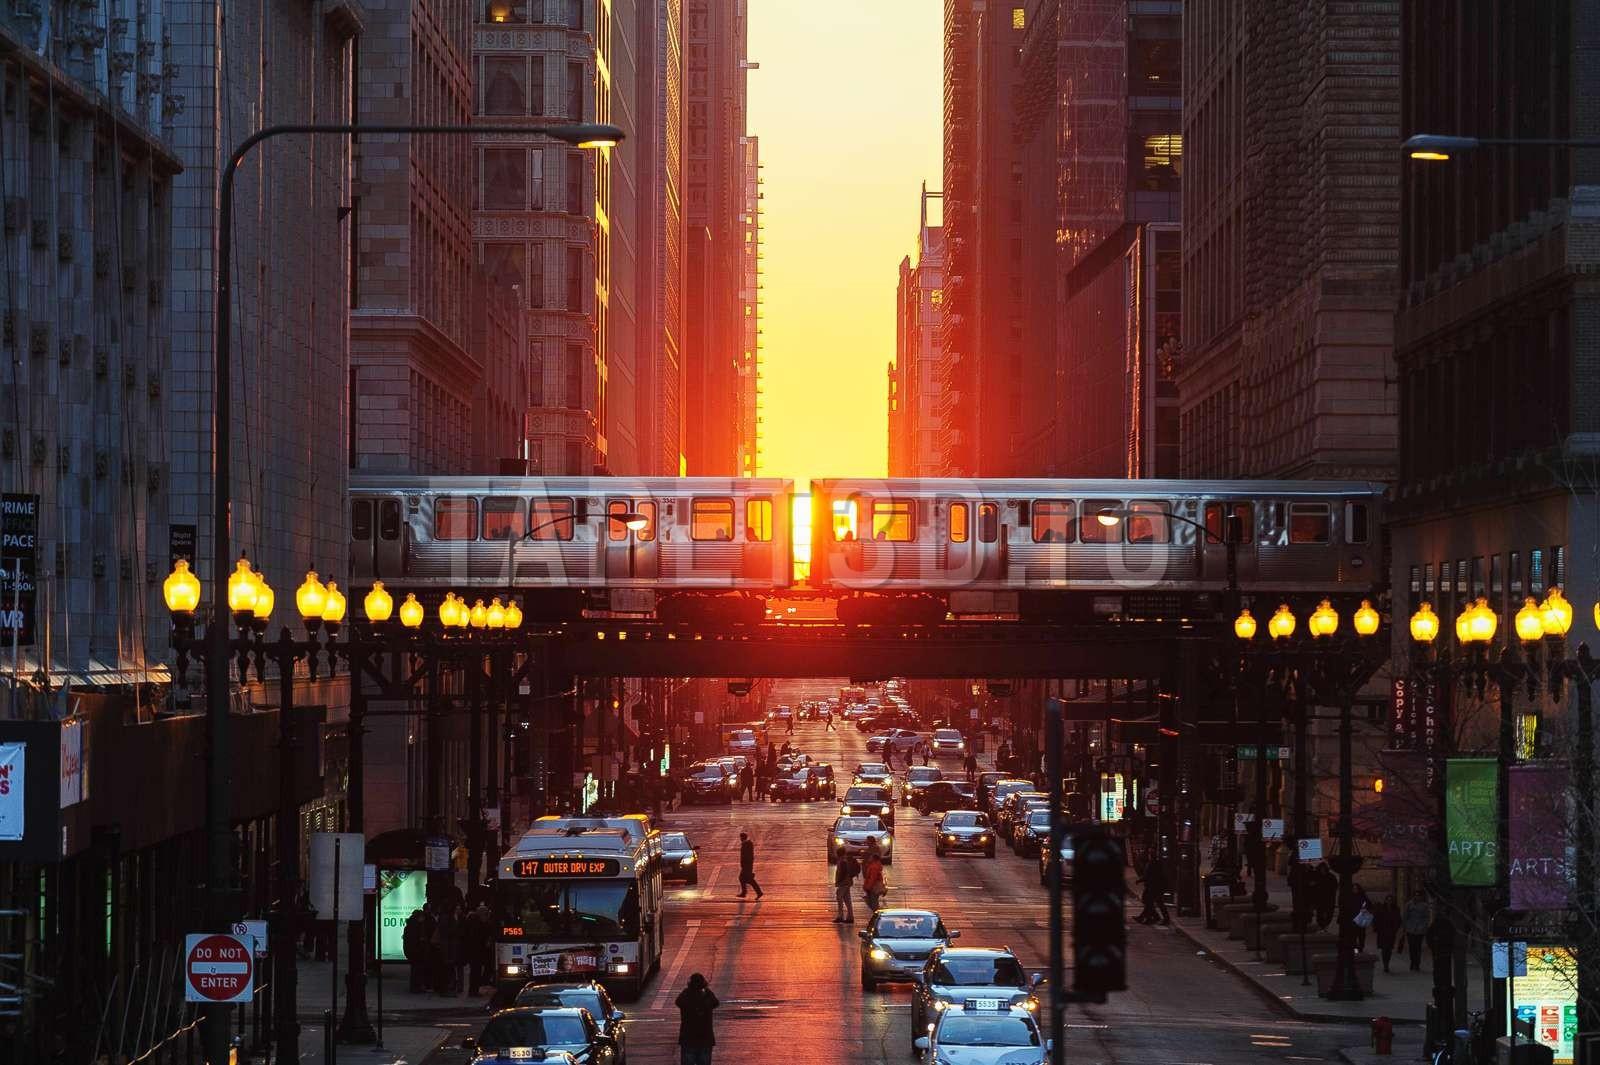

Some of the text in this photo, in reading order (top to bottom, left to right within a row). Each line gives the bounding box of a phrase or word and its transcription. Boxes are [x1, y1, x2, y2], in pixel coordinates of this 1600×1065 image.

[0, 501, 34, 515] PRIME
[1448, 841, 1496, 857] ARTS
[521, 861, 605, 875] 147 OUTER DRV EXP
[1510, 857, 1565, 875] ARTS
[196, 948, 242, 959] DO NOT
[201, 977, 238, 988] ENTER
